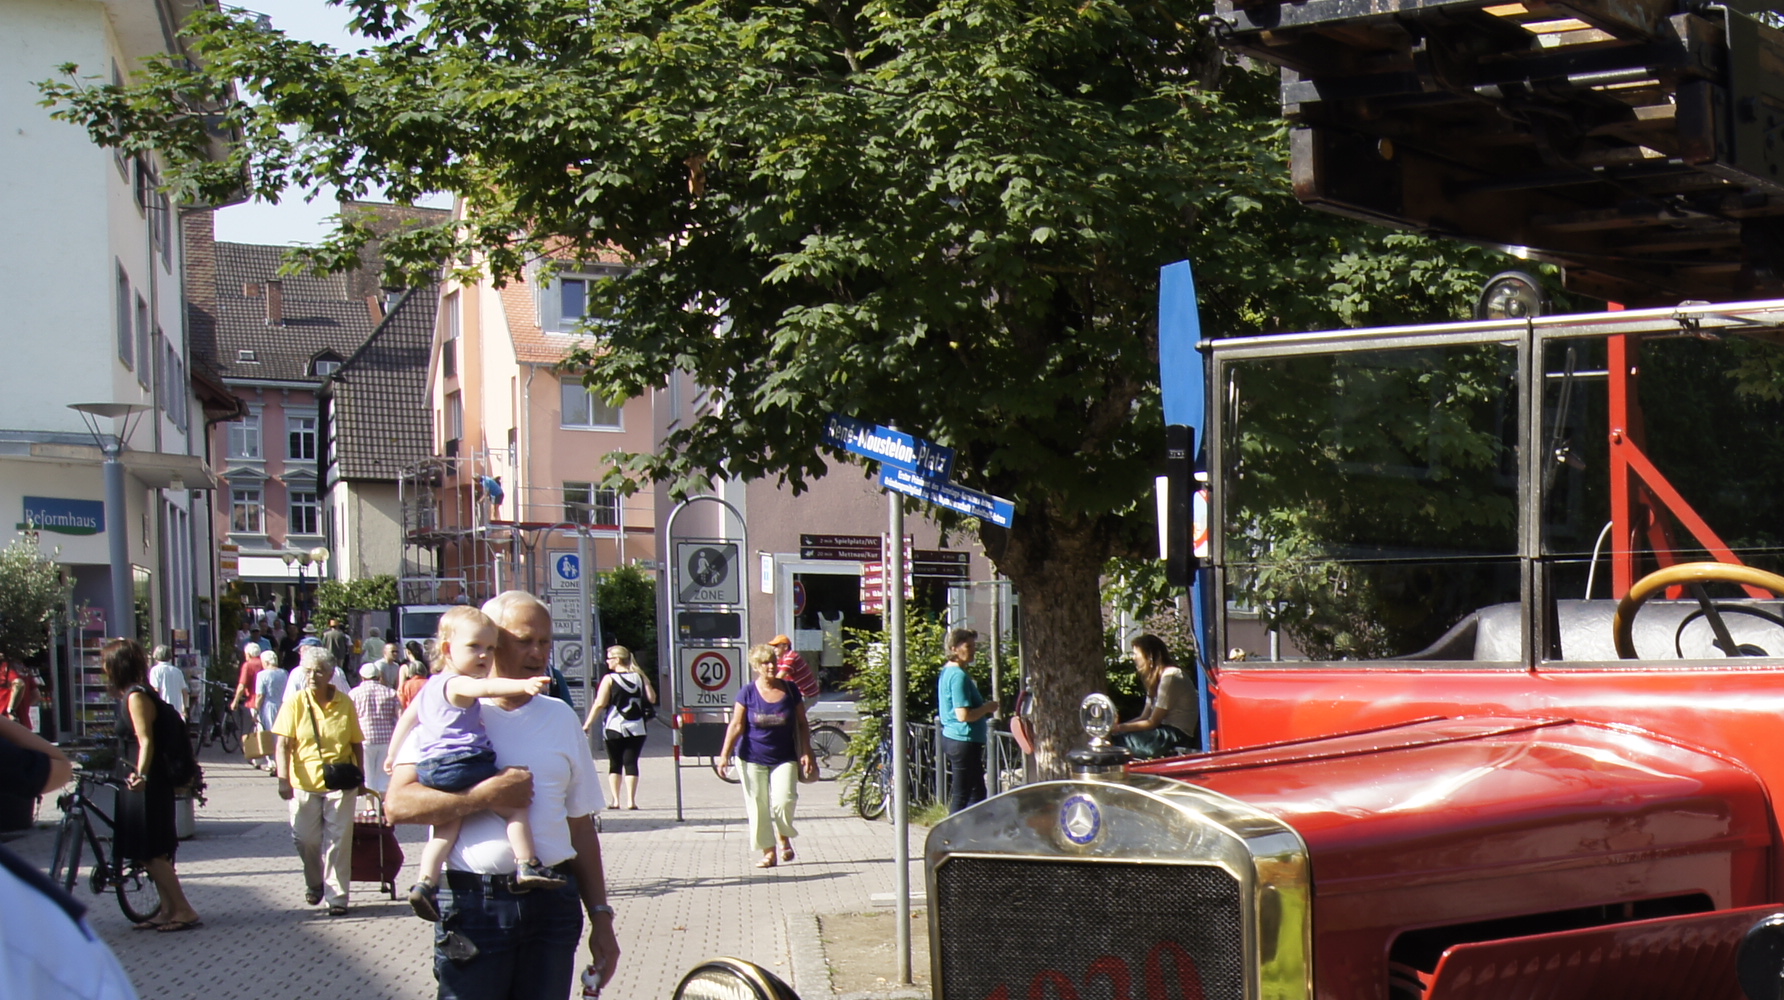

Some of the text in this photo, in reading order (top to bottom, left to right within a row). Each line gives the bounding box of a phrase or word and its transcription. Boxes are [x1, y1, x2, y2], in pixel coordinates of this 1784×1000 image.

[25, 509, 97, 530] Reformhaus
[834, 537, 878, 546] Spielplatz/WC
[694, 590, 725, 600] ZONE
[700, 662, 723, 680] 20
[697, 693, 727, 704] ZONE
